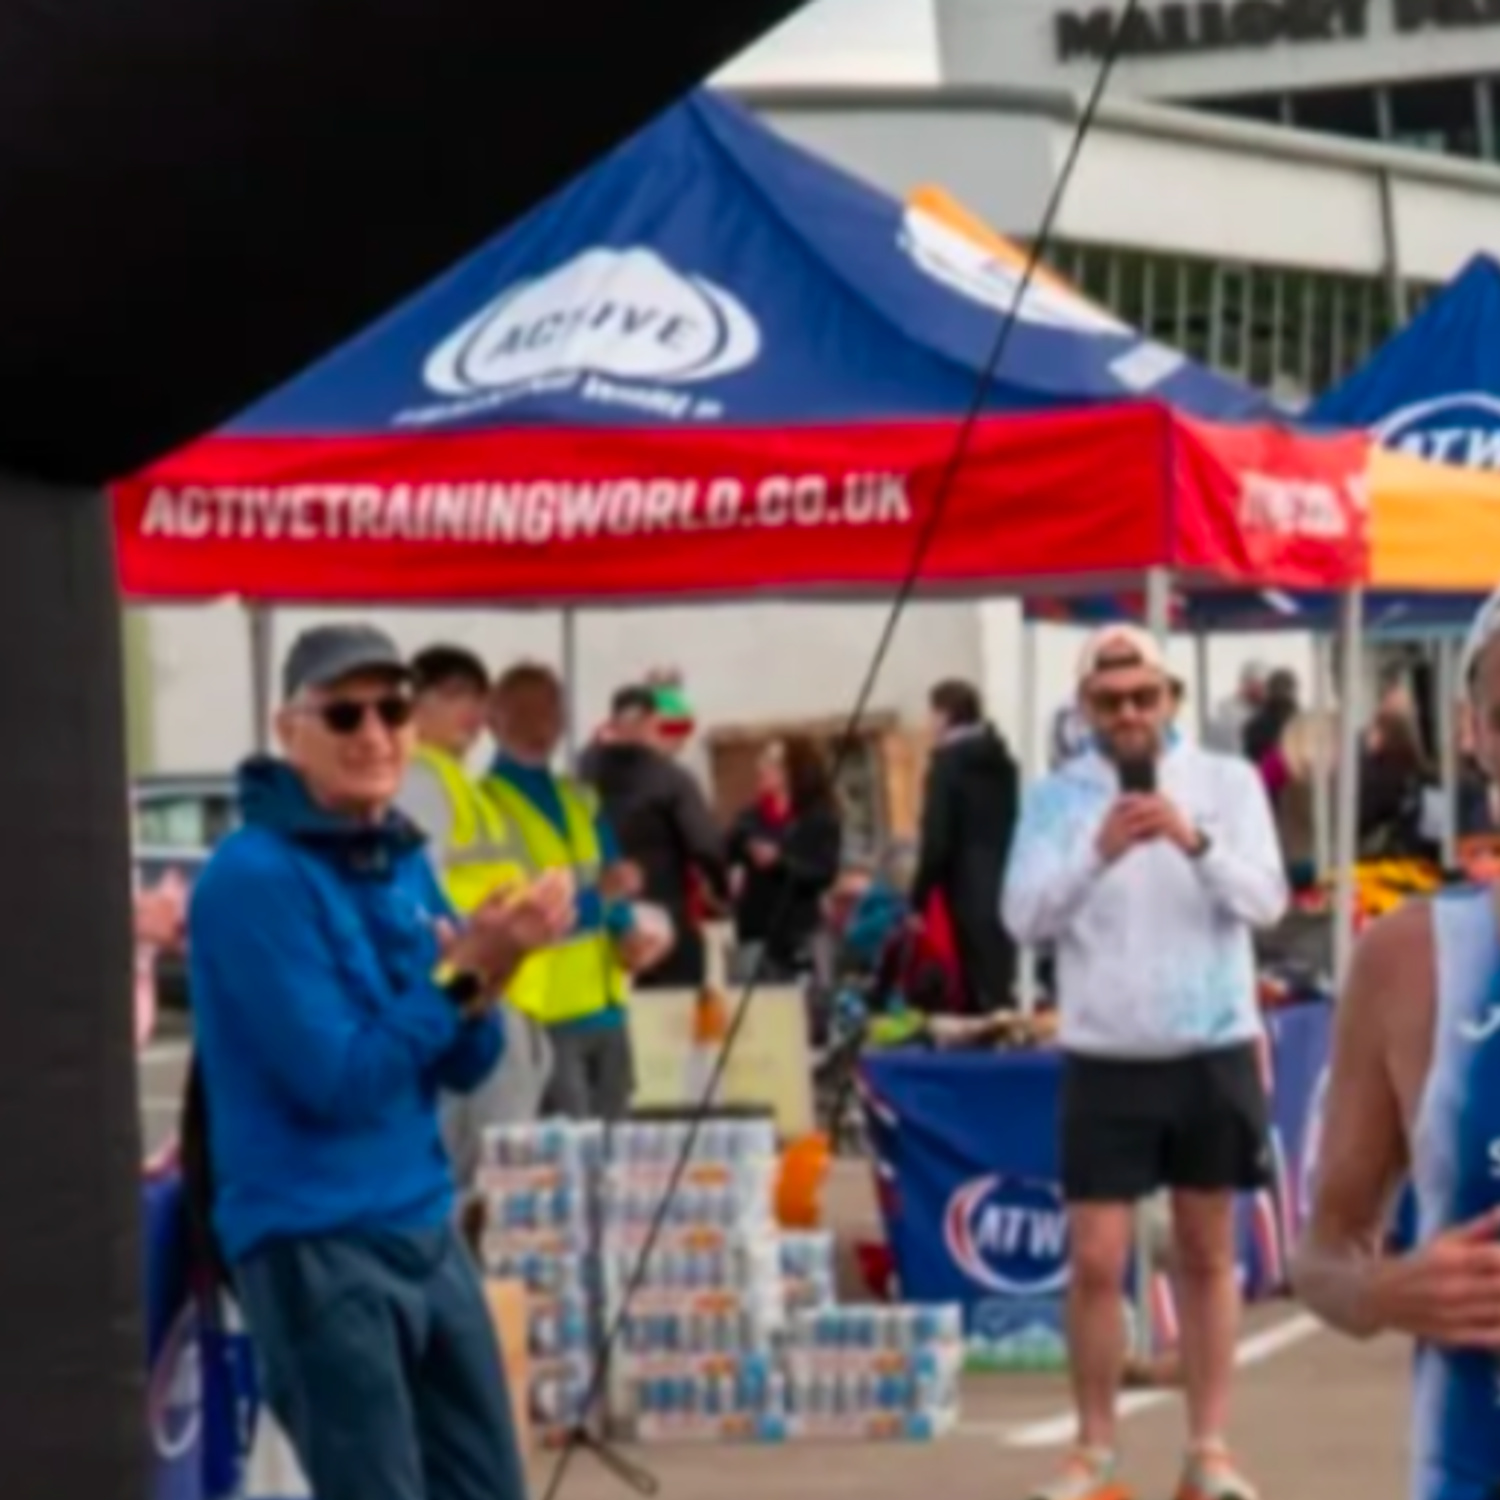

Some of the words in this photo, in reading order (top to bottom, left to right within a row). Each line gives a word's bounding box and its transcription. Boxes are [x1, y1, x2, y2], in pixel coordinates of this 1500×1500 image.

[1054, 0, 1366, 63] MALLORY
[484, 300, 700, 367] ACTIVE
[139, 471, 911, 545] ACTIVETRAININGWORLD.CO.UK
